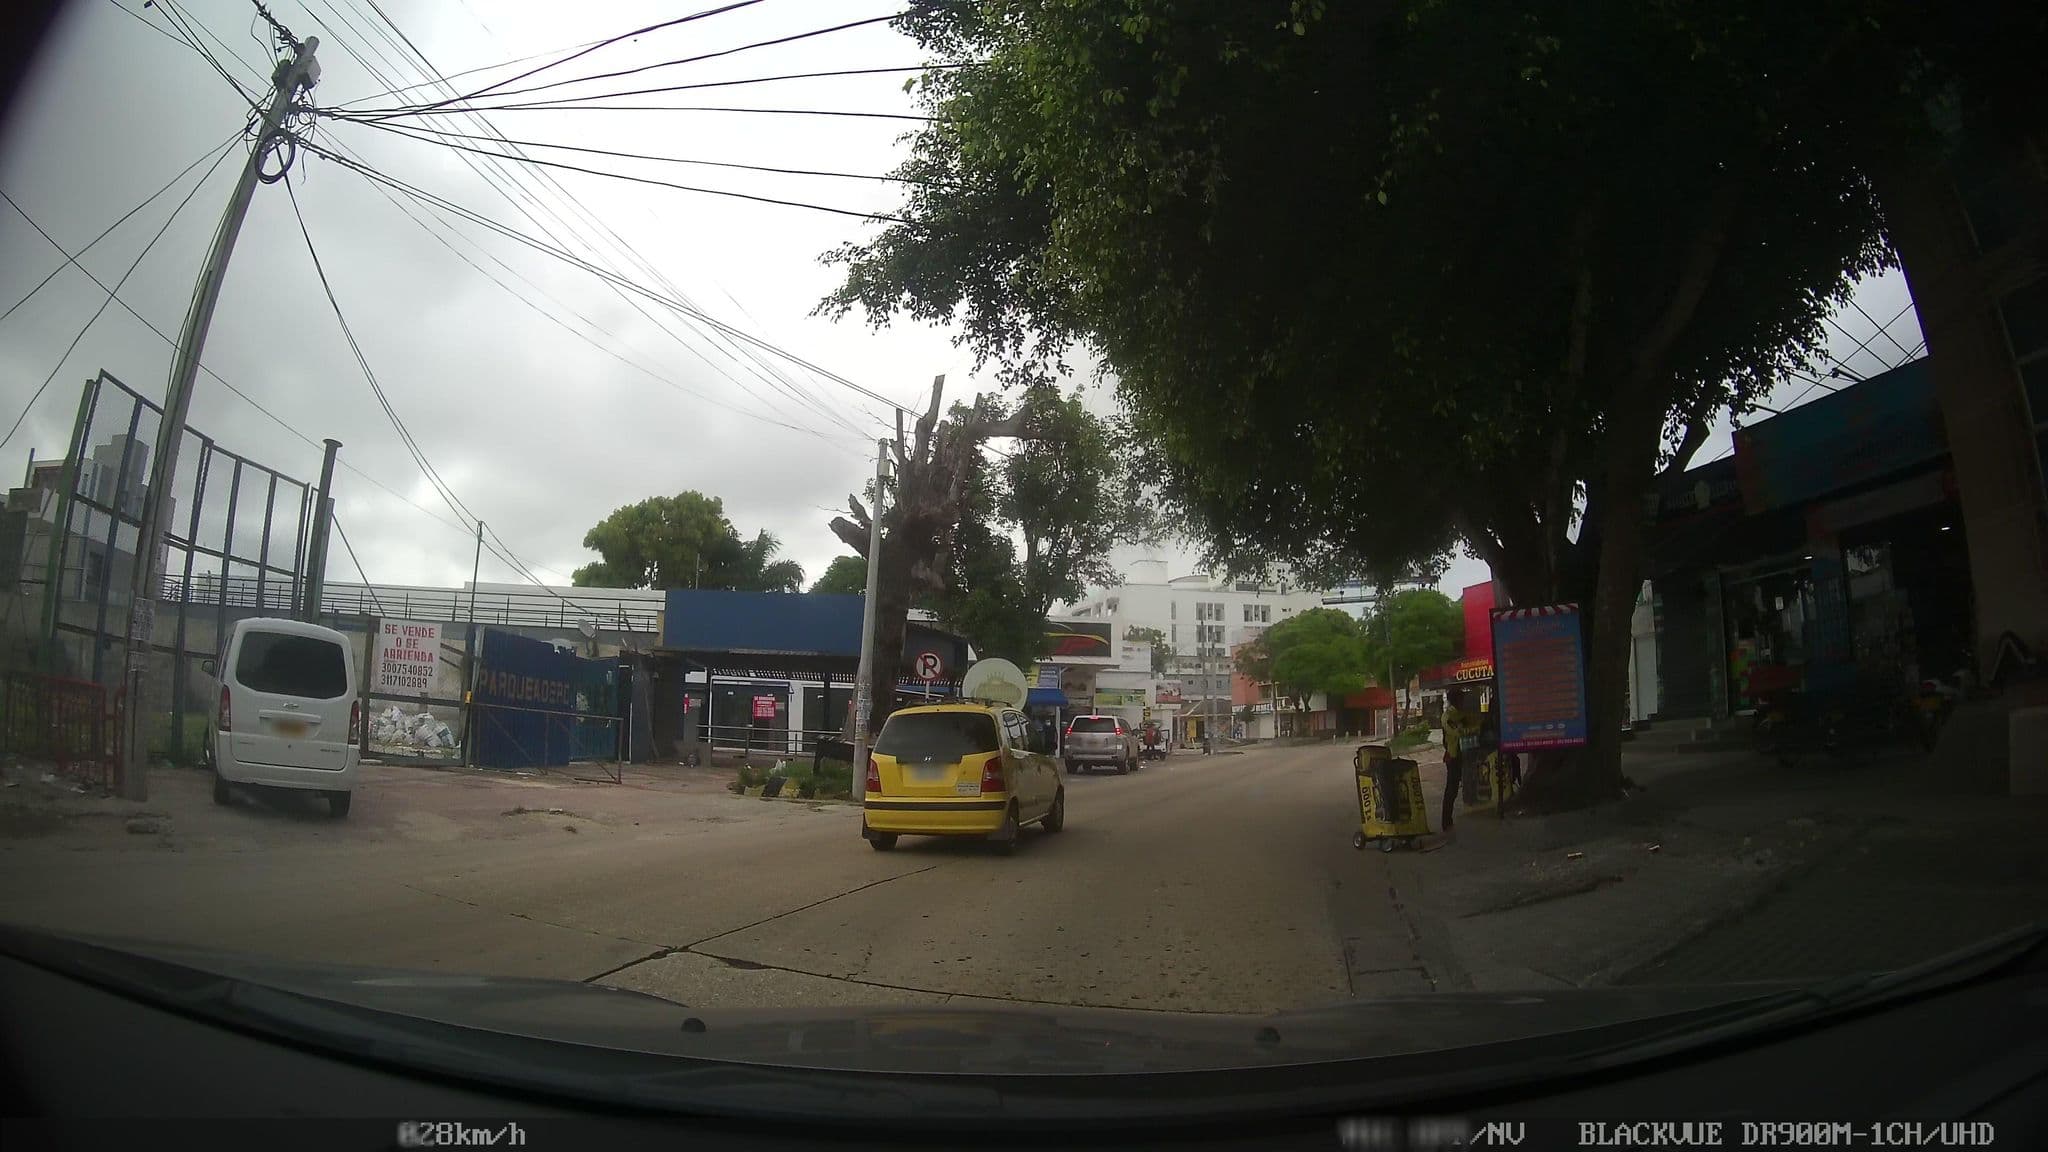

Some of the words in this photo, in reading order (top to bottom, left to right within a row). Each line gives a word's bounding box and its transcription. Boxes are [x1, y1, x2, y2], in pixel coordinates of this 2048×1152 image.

[385, 624, 398, 634] SE
[402, 625, 434, 638] VENDE
[396, 637, 401, 648] O
[406, 638, 418, 649] SE
[384, 648, 434, 663] ARRIENDA
[382, 663, 433, 676] 3007540852
